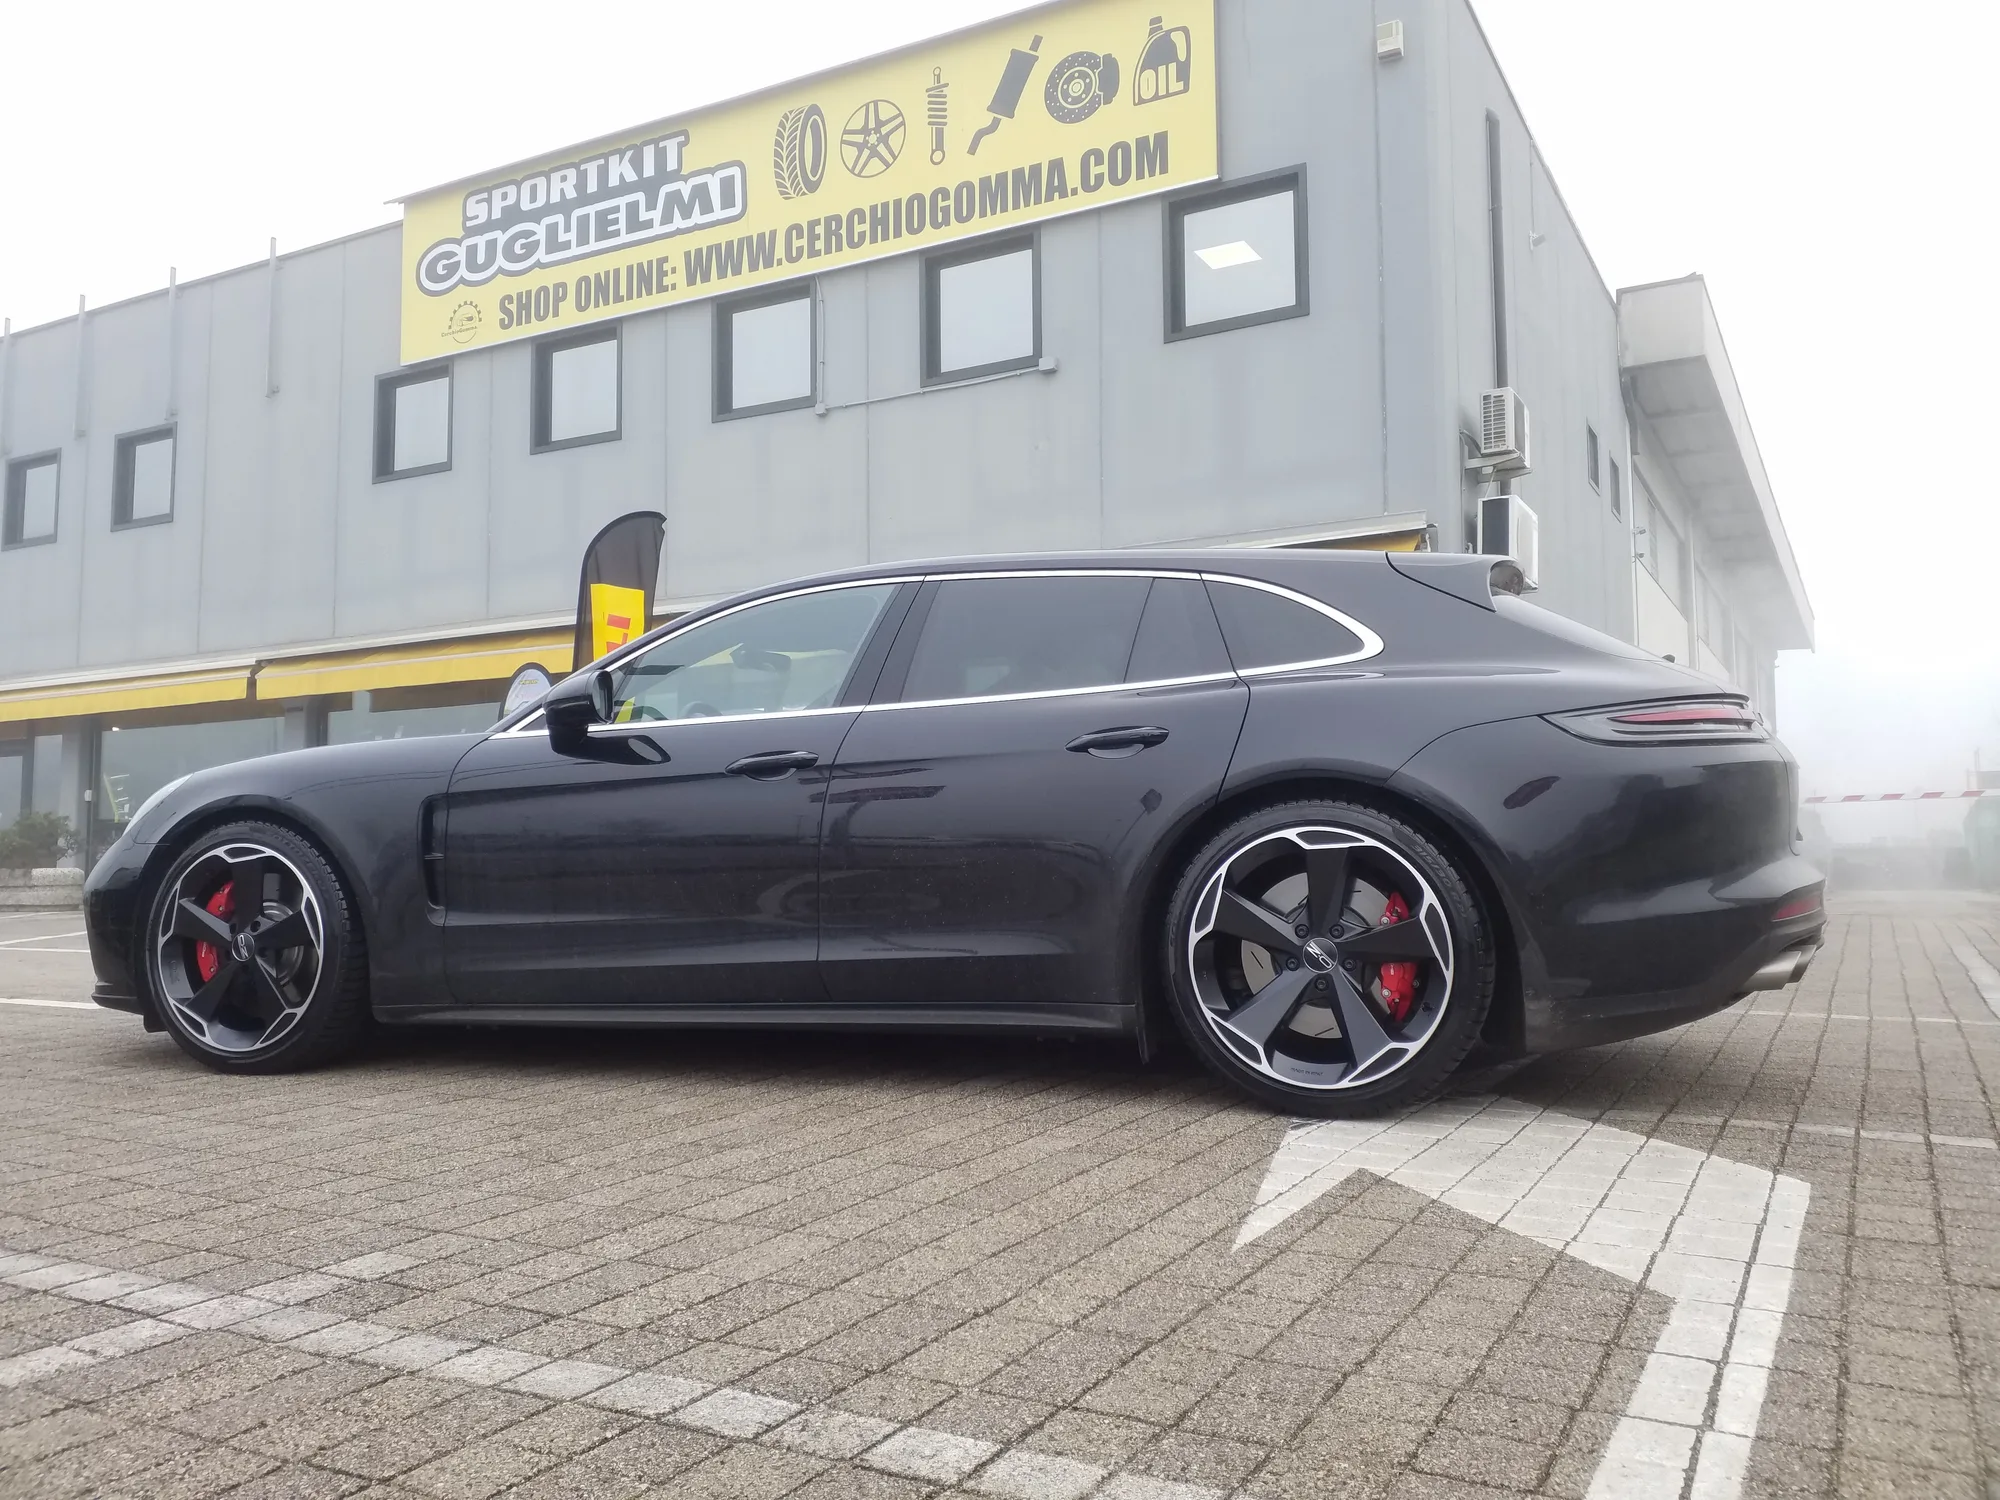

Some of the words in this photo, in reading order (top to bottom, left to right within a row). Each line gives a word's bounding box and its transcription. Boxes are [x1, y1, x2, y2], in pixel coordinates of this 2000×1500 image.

[1139, 61, 1184, 100] OIL
[420, 167, 741, 292] GUGLIELMI
[465, 135, 685, 228] SPORTKIT
[499, 281, 568, 331] SHOP
[575, 255, 677, 313] ONLINE:
[684, 130, 1170, 287] WWW.CERCHIOGOMMA.COM
